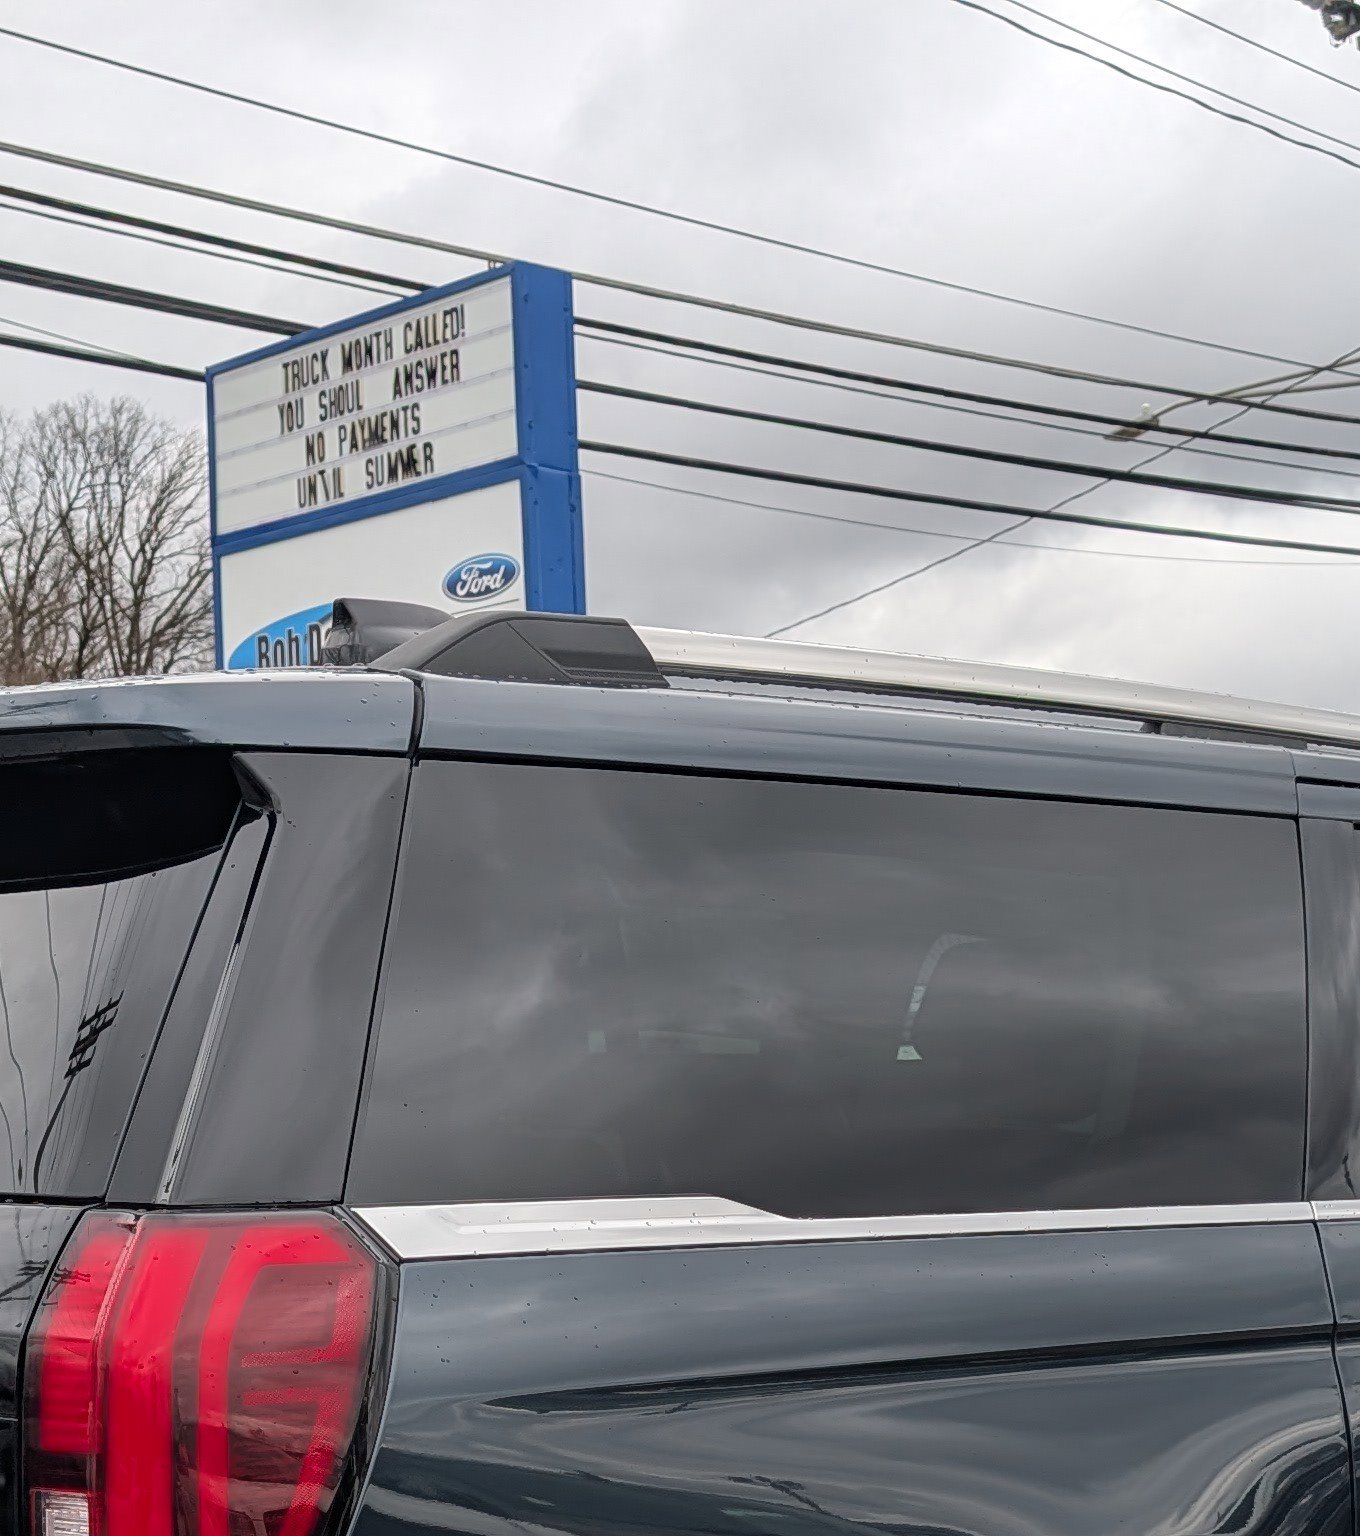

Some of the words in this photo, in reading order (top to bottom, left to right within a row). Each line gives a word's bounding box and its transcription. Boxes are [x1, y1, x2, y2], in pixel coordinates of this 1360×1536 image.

[283, 349, 330, 395] TRUCK
[341, 326, 394, 375] MONTH
[403, 303, 466, 357] CALLED!
[278, 401, 304, 436] YOU
[319, 378, 363, 423] SHOUL
[392, 349, 460, 401] ANSWER
[305, 432, 326, 467] NO
[339, 403, 421, 454] PAYMENTS
[297, 467, 344, 509] UNTIL
[365, 441, 435, 490] SUMMER
[456, 560, 506, 598] Ford
